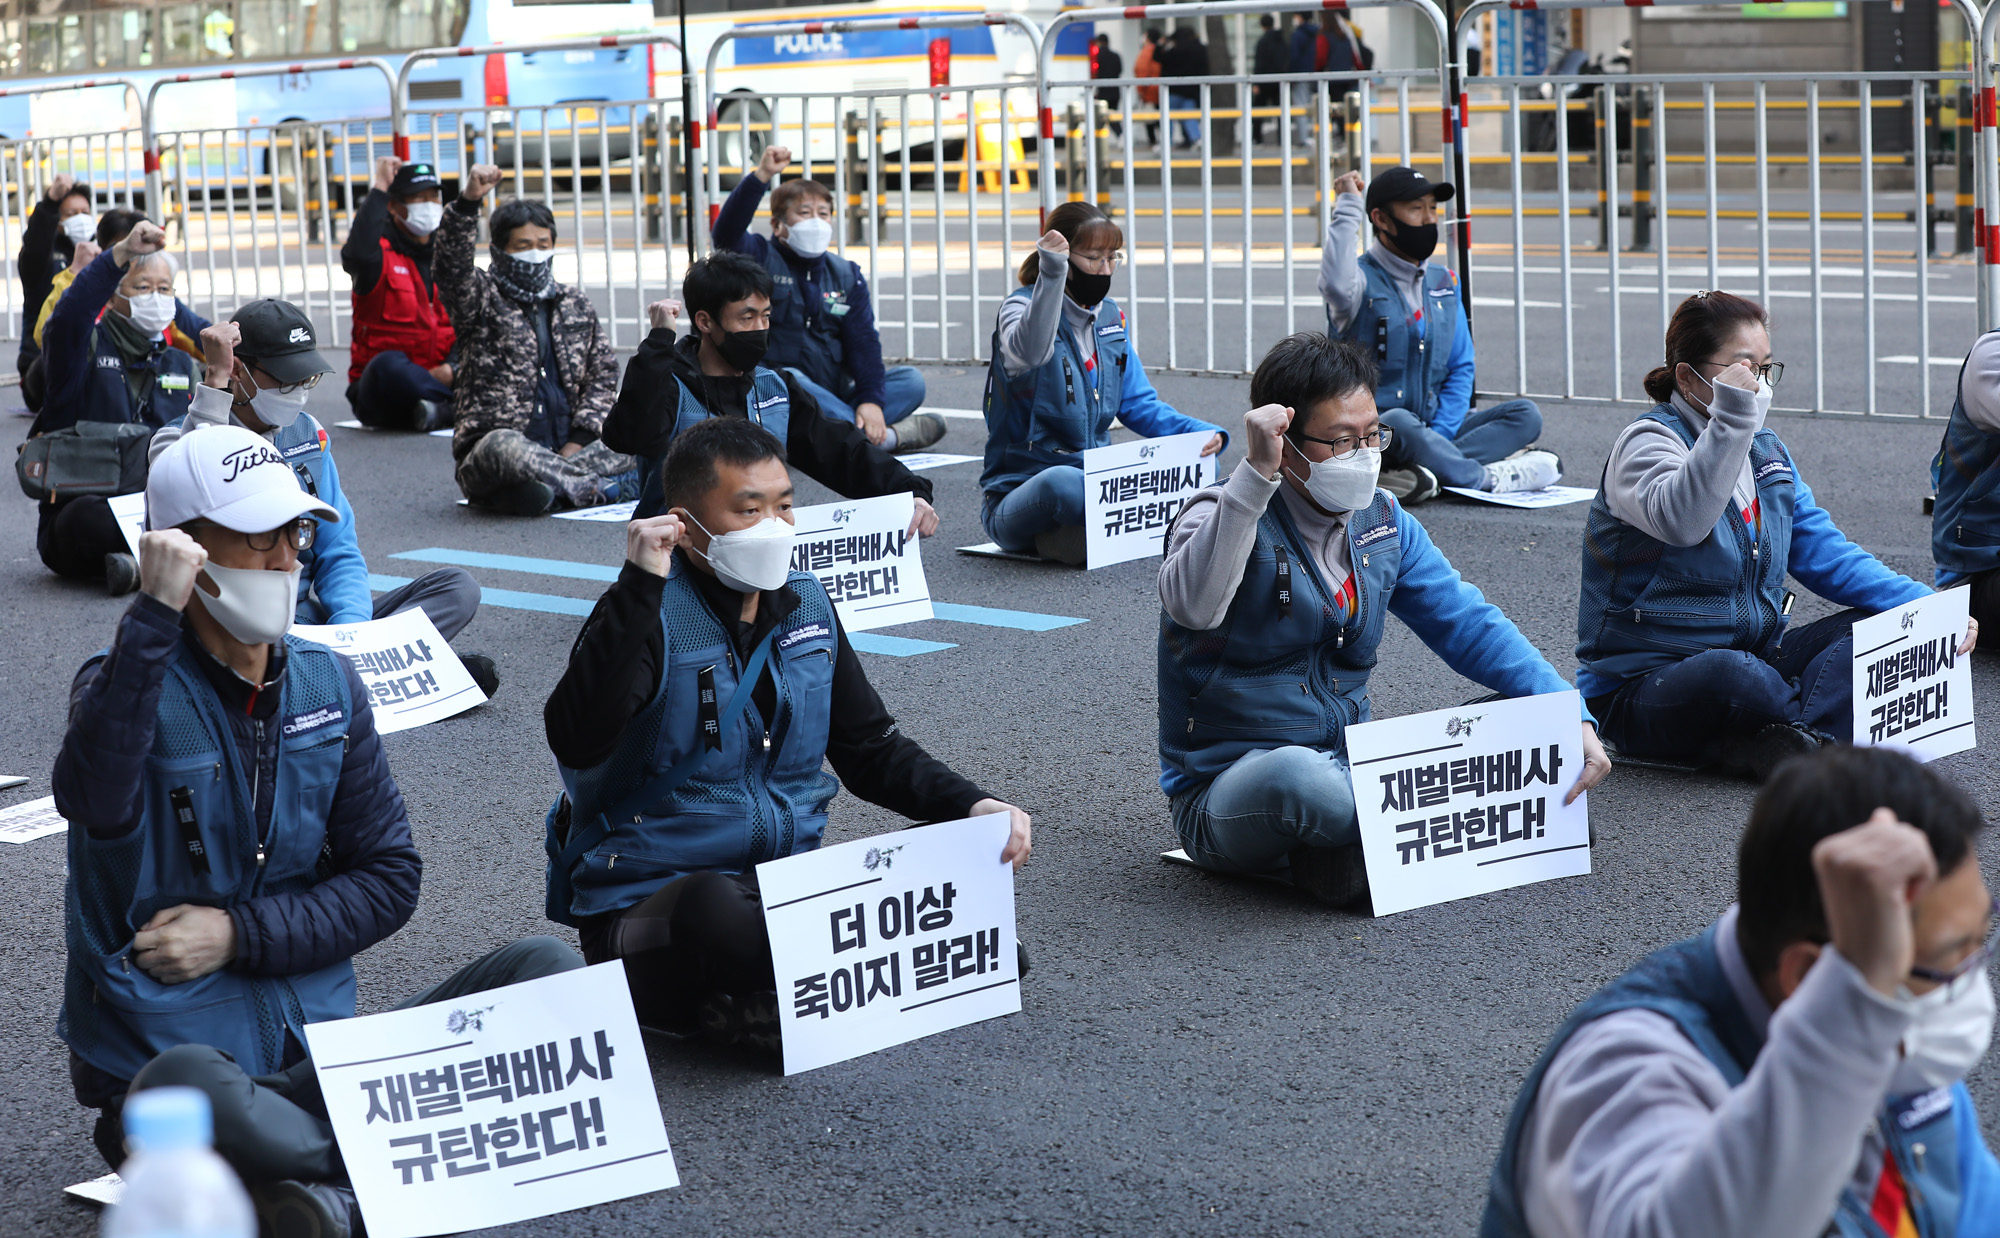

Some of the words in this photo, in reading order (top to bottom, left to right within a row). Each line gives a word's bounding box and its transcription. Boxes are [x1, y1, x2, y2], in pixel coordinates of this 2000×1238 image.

[774, 33, 844, 55] POLICE
[1099, 463, 1203, 505] 재벌택배사
[789, 529, 907, 572] 재벌택배사
[819, 565, 899, 604] 탄한다!
[348, 639, 433, 676] 택배사
[366, 669, 440, 709] 한다!
[1866, 633, 1958, 700] 재벌택배사
[1870, 680, 1948, 745] 규탄한다!
[1379, 744, 1563, 814] 재벌택배사
[1395, 797, 1546, 866] 규탄한다!
[830, 902, 867, 955] 더
[878, 881, 957, 940] 이상
[794, 951, 902, 1020] 죽이지
[912, 926, 1000, 991] 말라!
[359, 1029, 615, 1126] 재벌택배사
[389, 1096, 608, 1185] 규탄한다!
